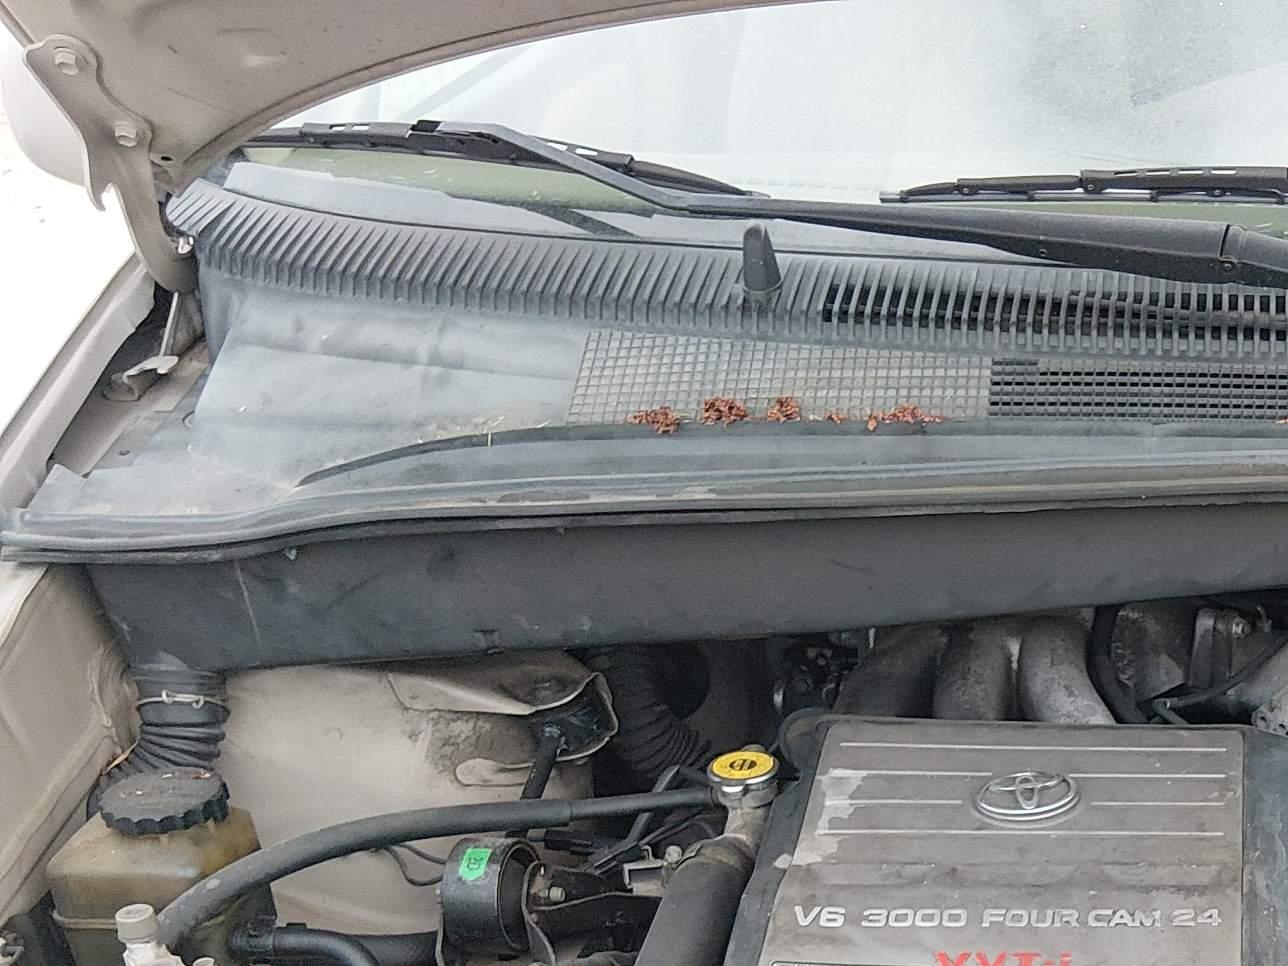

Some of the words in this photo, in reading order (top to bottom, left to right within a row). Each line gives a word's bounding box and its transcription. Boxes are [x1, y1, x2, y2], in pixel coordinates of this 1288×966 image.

[794, 906, 846, 928] V6
[862, 908, 968, 928] 3000
[981, 908, 1081, 928] FOUR
[1087, 909, 1162, 928] CAM
[1171, 908, 1222, 927] 24
